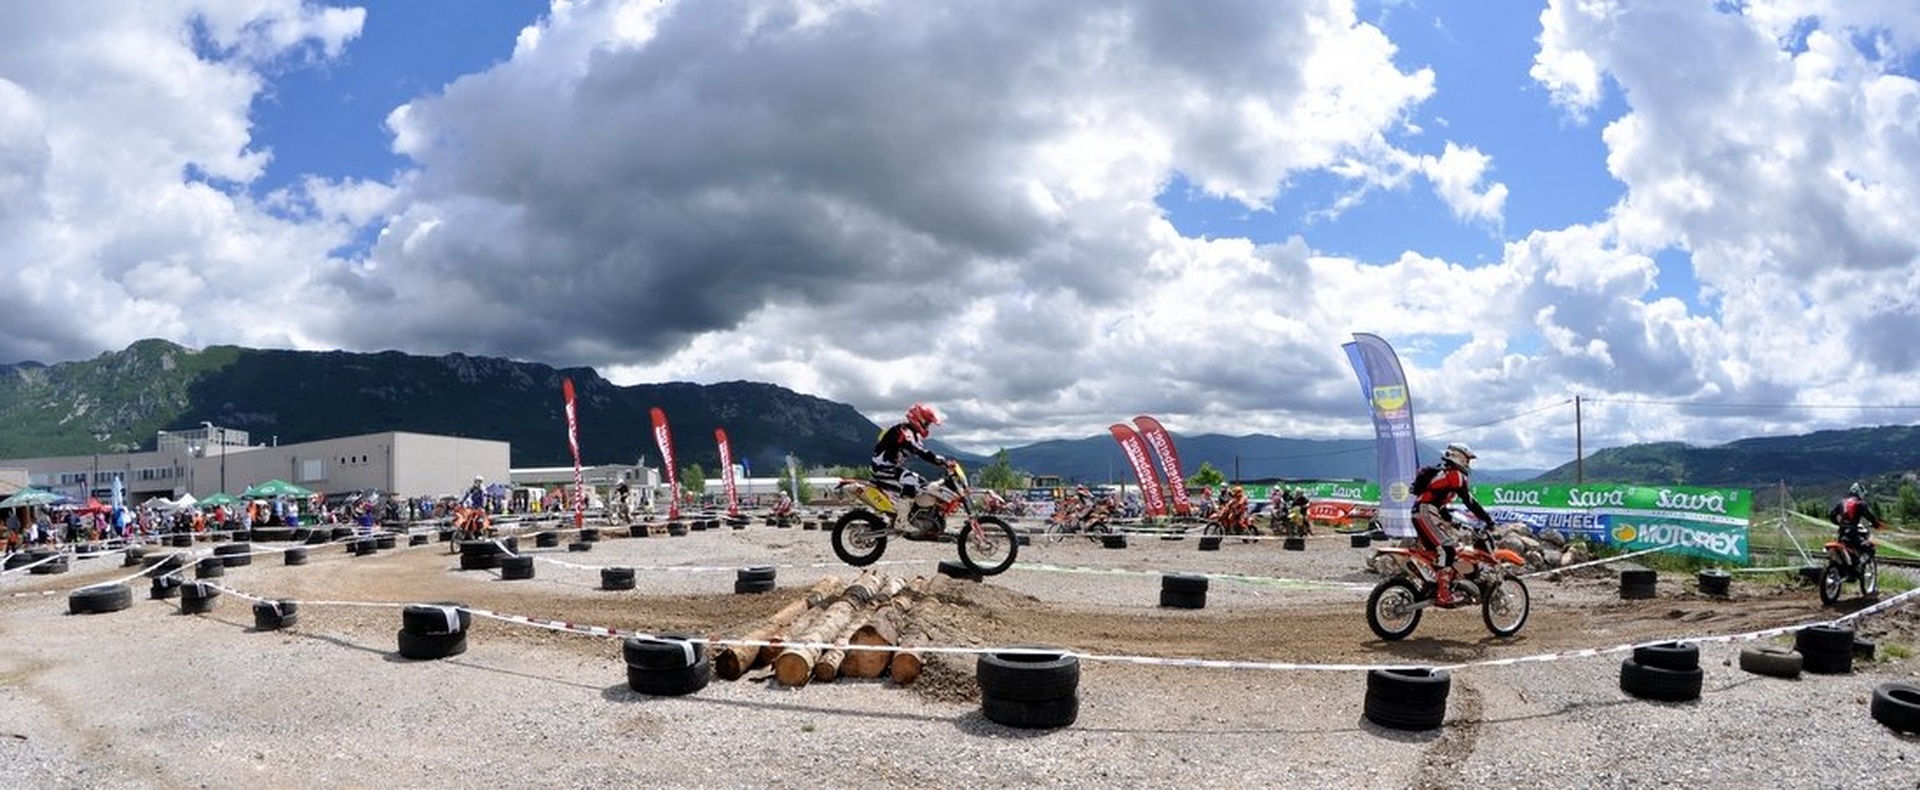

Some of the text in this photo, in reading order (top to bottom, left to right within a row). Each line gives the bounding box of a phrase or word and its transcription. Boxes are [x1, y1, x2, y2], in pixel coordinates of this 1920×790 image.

[1331, 484, 1362, 499] Sava
[1493, 487, 1540, 504] Sava
[1567, 488, 1624, 507] Sava
[1656, 489, 1727, 513] Sava
[1549, 513, 1606, 528] WHEEL
[1638, 524, 1741, 556] MOTOREX
